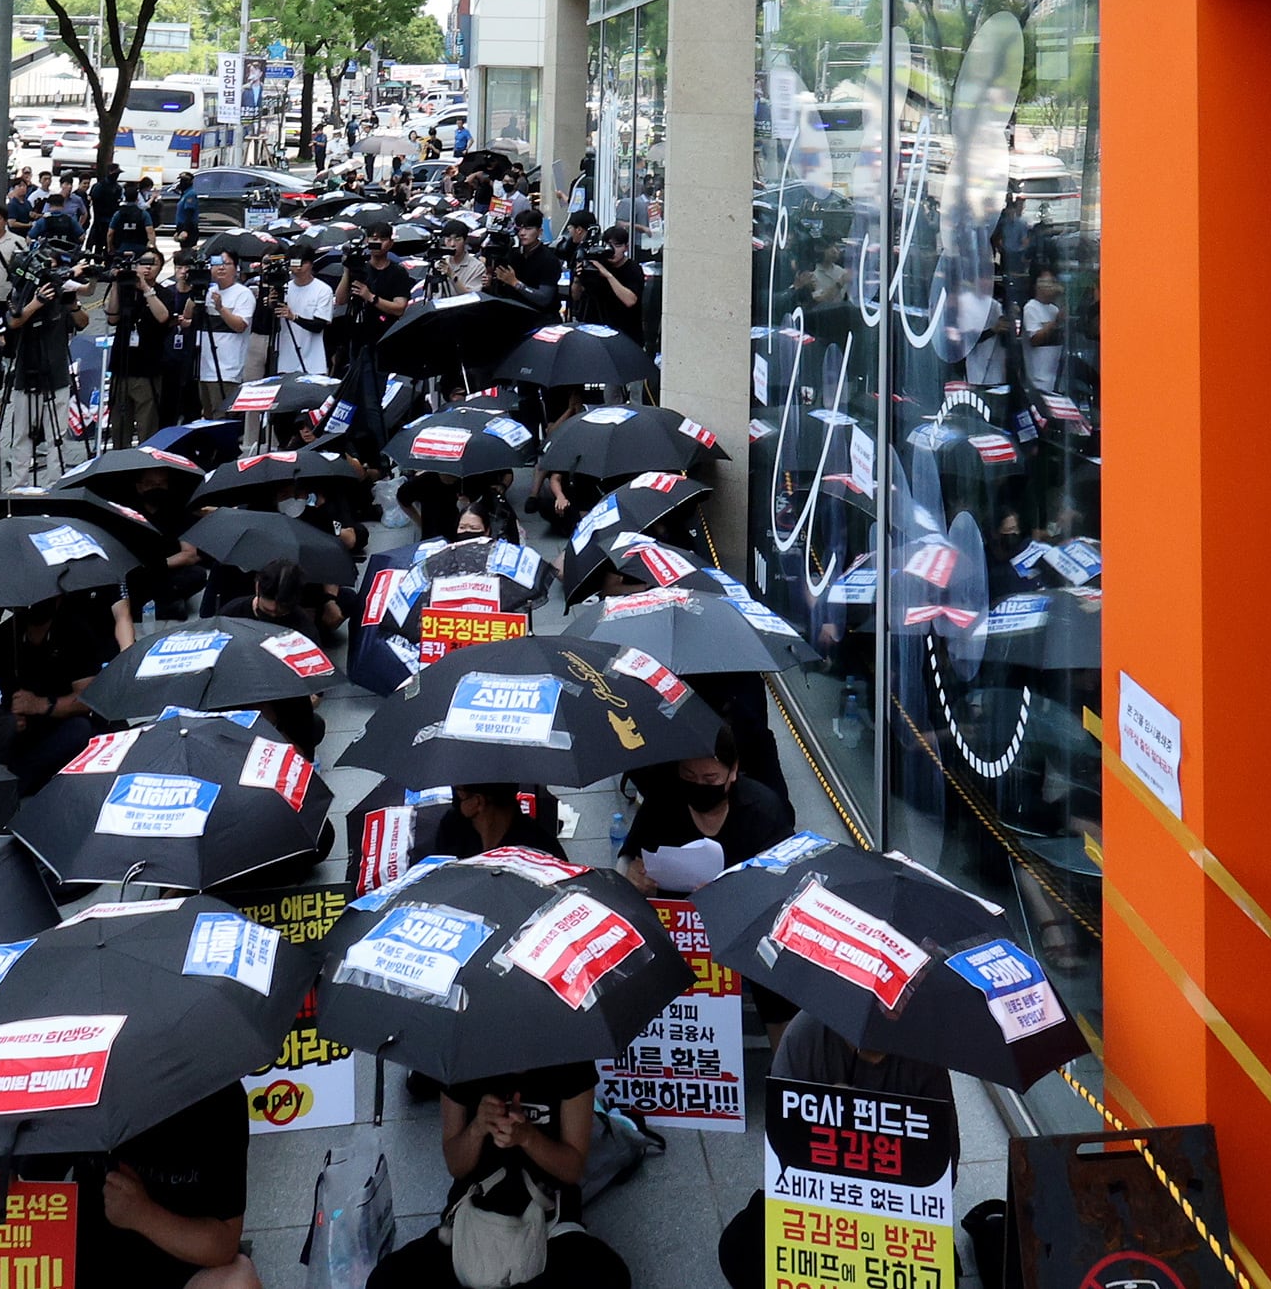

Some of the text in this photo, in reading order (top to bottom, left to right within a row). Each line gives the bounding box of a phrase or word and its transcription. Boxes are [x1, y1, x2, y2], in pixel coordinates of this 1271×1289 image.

[223, 60, 237, 105] 임한별
[422, 615, 526, 642] 한국정보통신
[422, 641, 447, 658] 즉각
[470, 690, 541, 709] 소비자
[126, 783, 199, 807] 피해자
[242, 891, 346, 923] 자의 애타는
[384, 918, 464, 952] 소비자
[980, 957, 1032, 989] 소비자
[669, 1004, 698, 1022] 회피
[43, 1025, 106, 1044] 희생양!
[669, 1025, 715, 1043] 금융사
[614, 1046, 721, 1078] 빠른 환불
[28, 1067, 93, 1090] 판매자!
[603, 1079, 739, 1114] 진행하라!!!
[782, 1090, 844, 1127] PG사
[809, 1125, 902, 1176] 금감원
[774, 1172, 945, 1219] 소비자 보호 없는 나라
[783, 1208, 937, 1263] 금감원의 방관
[776, 1245, 942, 1289] 티메프에 당하고
